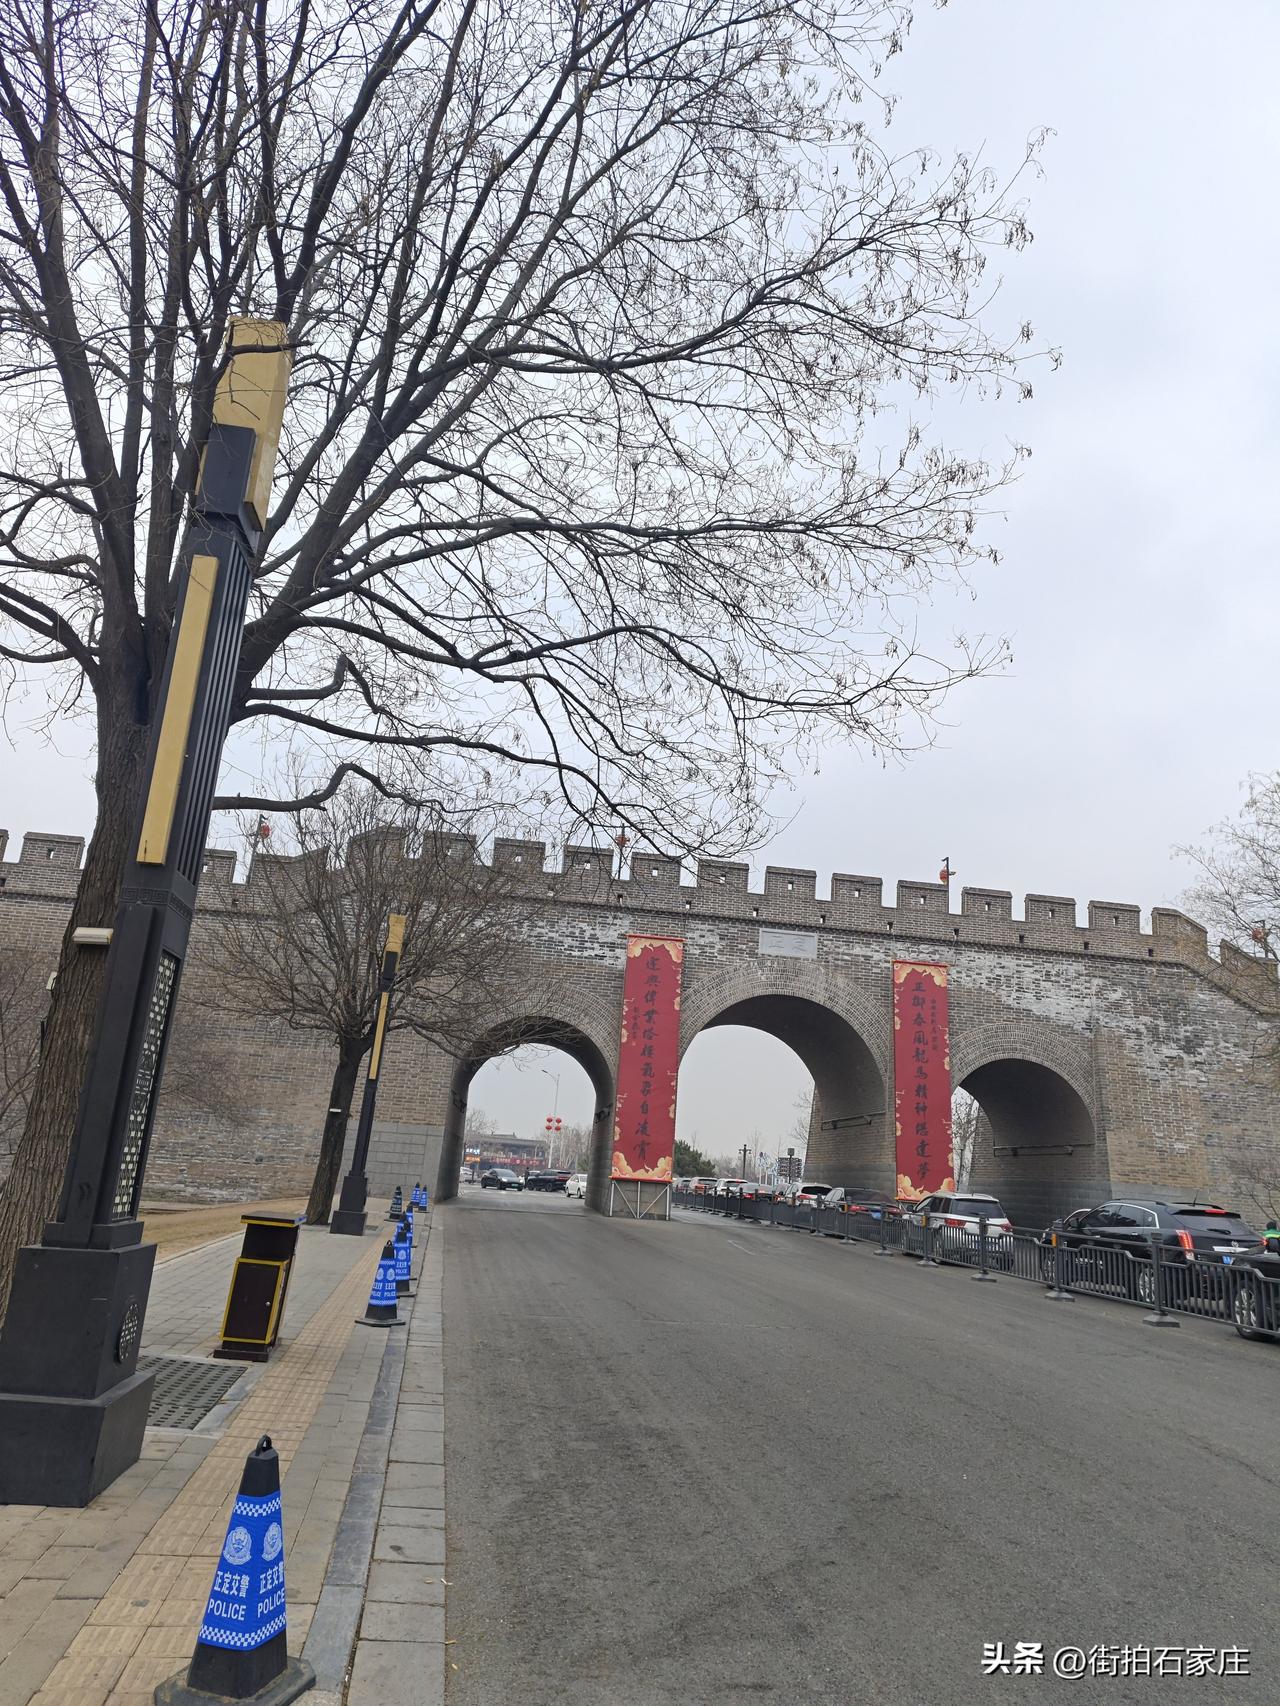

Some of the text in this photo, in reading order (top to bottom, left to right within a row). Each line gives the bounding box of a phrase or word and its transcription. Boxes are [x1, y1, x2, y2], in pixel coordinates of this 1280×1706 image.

[214, 1570, 249, 1598] 正定交警
[207, 1598, 247, 1621] POLICE
[257, 1587, 285, 1618] POLICE
